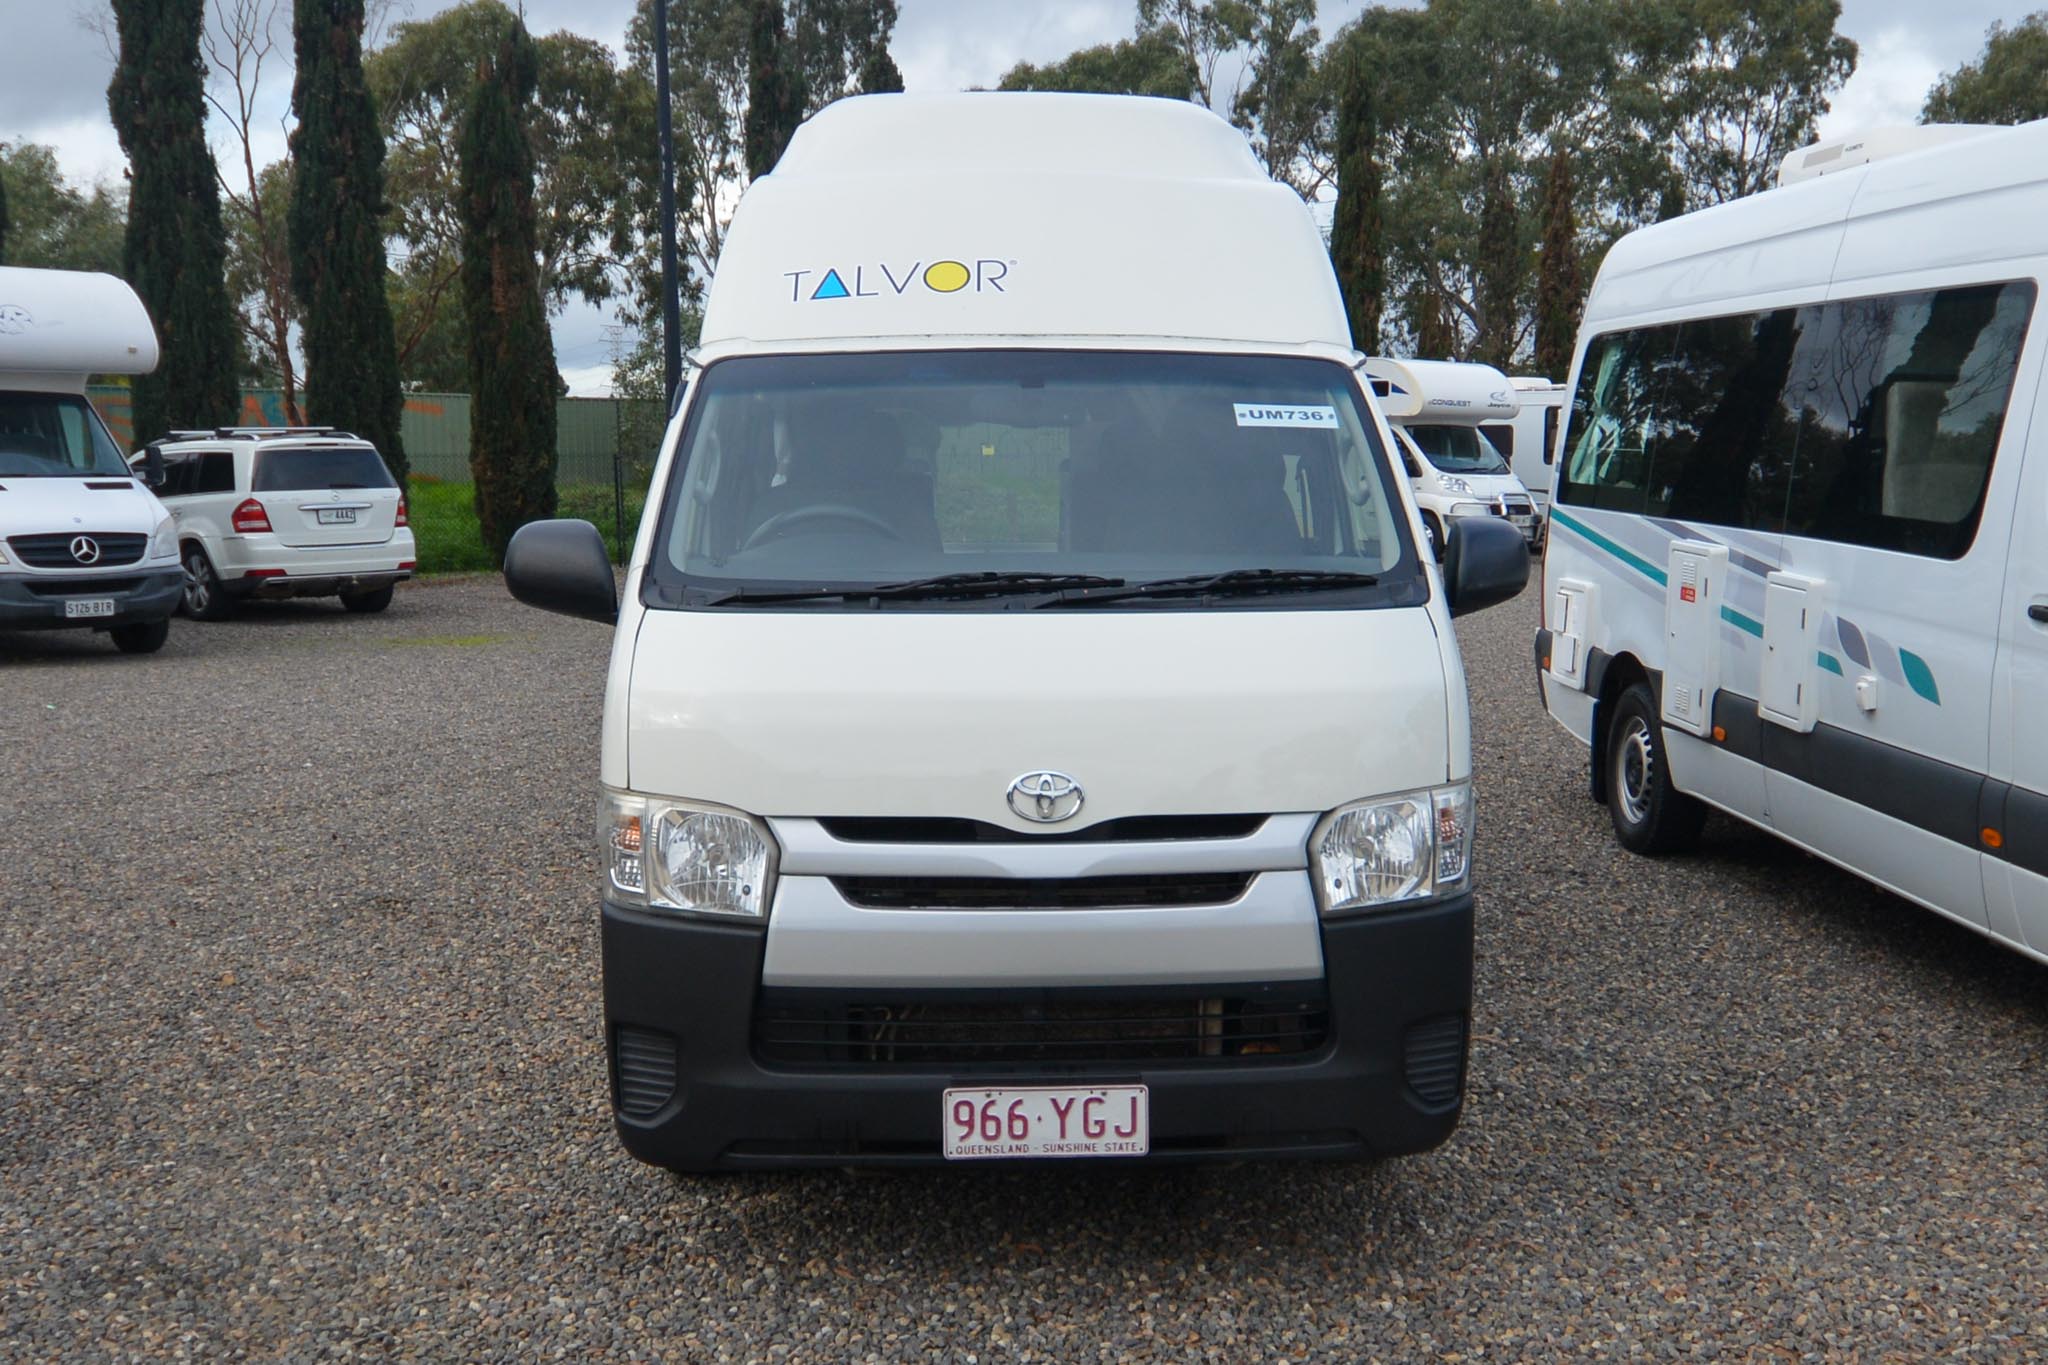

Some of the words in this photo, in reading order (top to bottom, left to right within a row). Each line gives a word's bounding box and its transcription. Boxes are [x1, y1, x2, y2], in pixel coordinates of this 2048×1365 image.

[784, 260, 1008, 302] TALVOR
[1248, 409, 1324, 421] UM736
[956, 1144, 1029, 1155] QUEENSLAND
[1042, 1142, 1098, 1153] SUNSHINE
[1104, 1141, 1137, 1152] STATE
